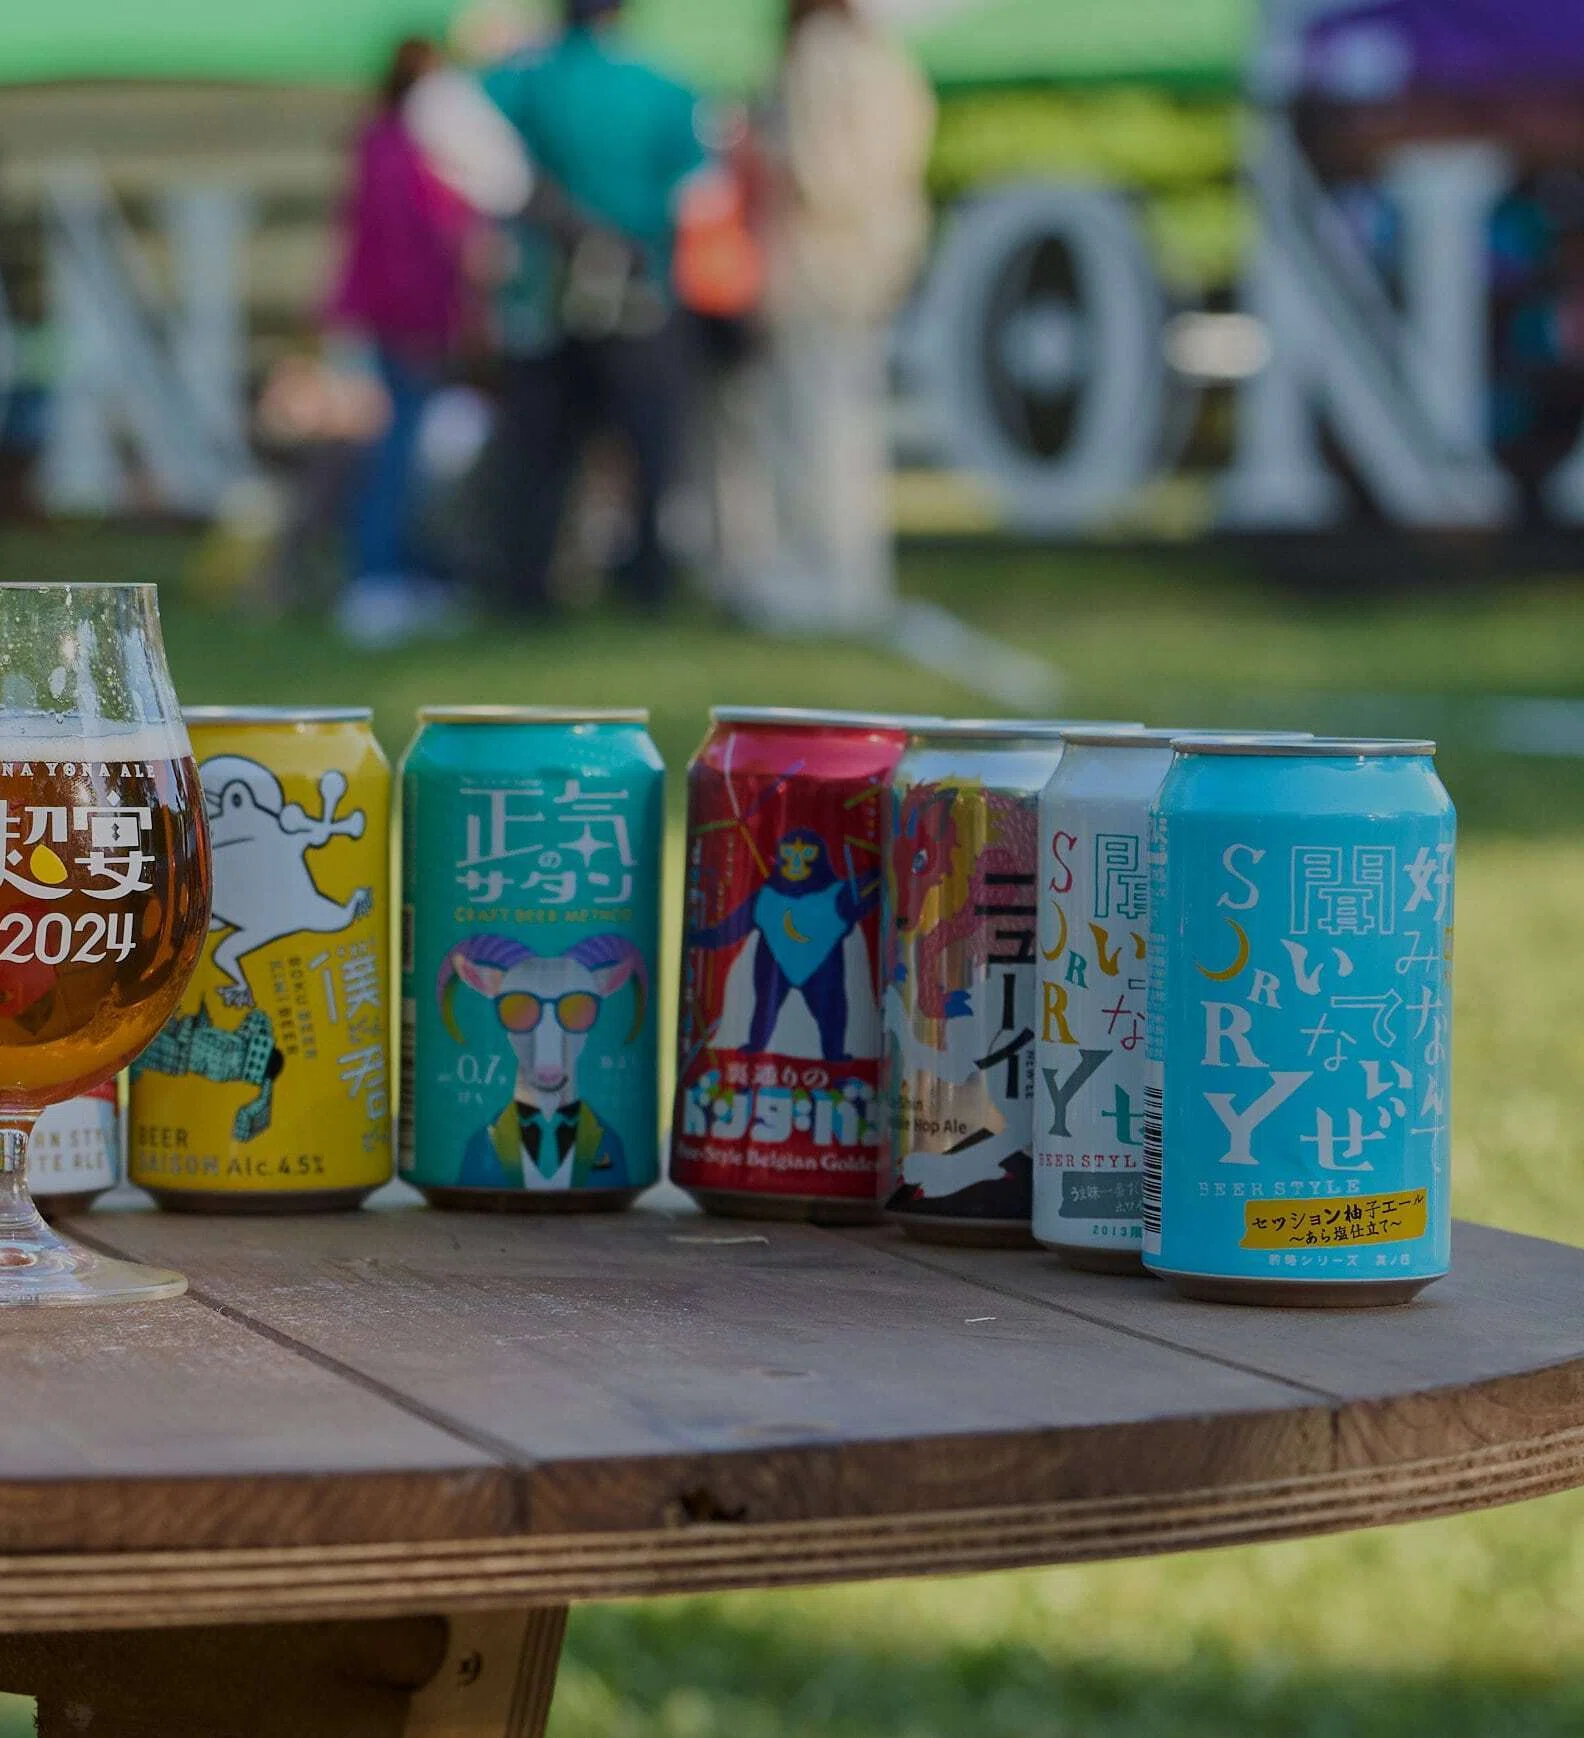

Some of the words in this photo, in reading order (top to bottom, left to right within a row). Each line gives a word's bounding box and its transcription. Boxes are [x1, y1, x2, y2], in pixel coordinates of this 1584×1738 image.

[47, 763, 111, 777] YONA
[120, 763, 156, 779] ALE
[456, 870, 633, 904] サタン
[138, 1126, 189, 1149] BEER
[1198, 1180, 1265, 1197] BEER
[1273, 1178, 1361, 1196] STYLE
[1251, 1192, 1426, 1233] セッション柚子エール
